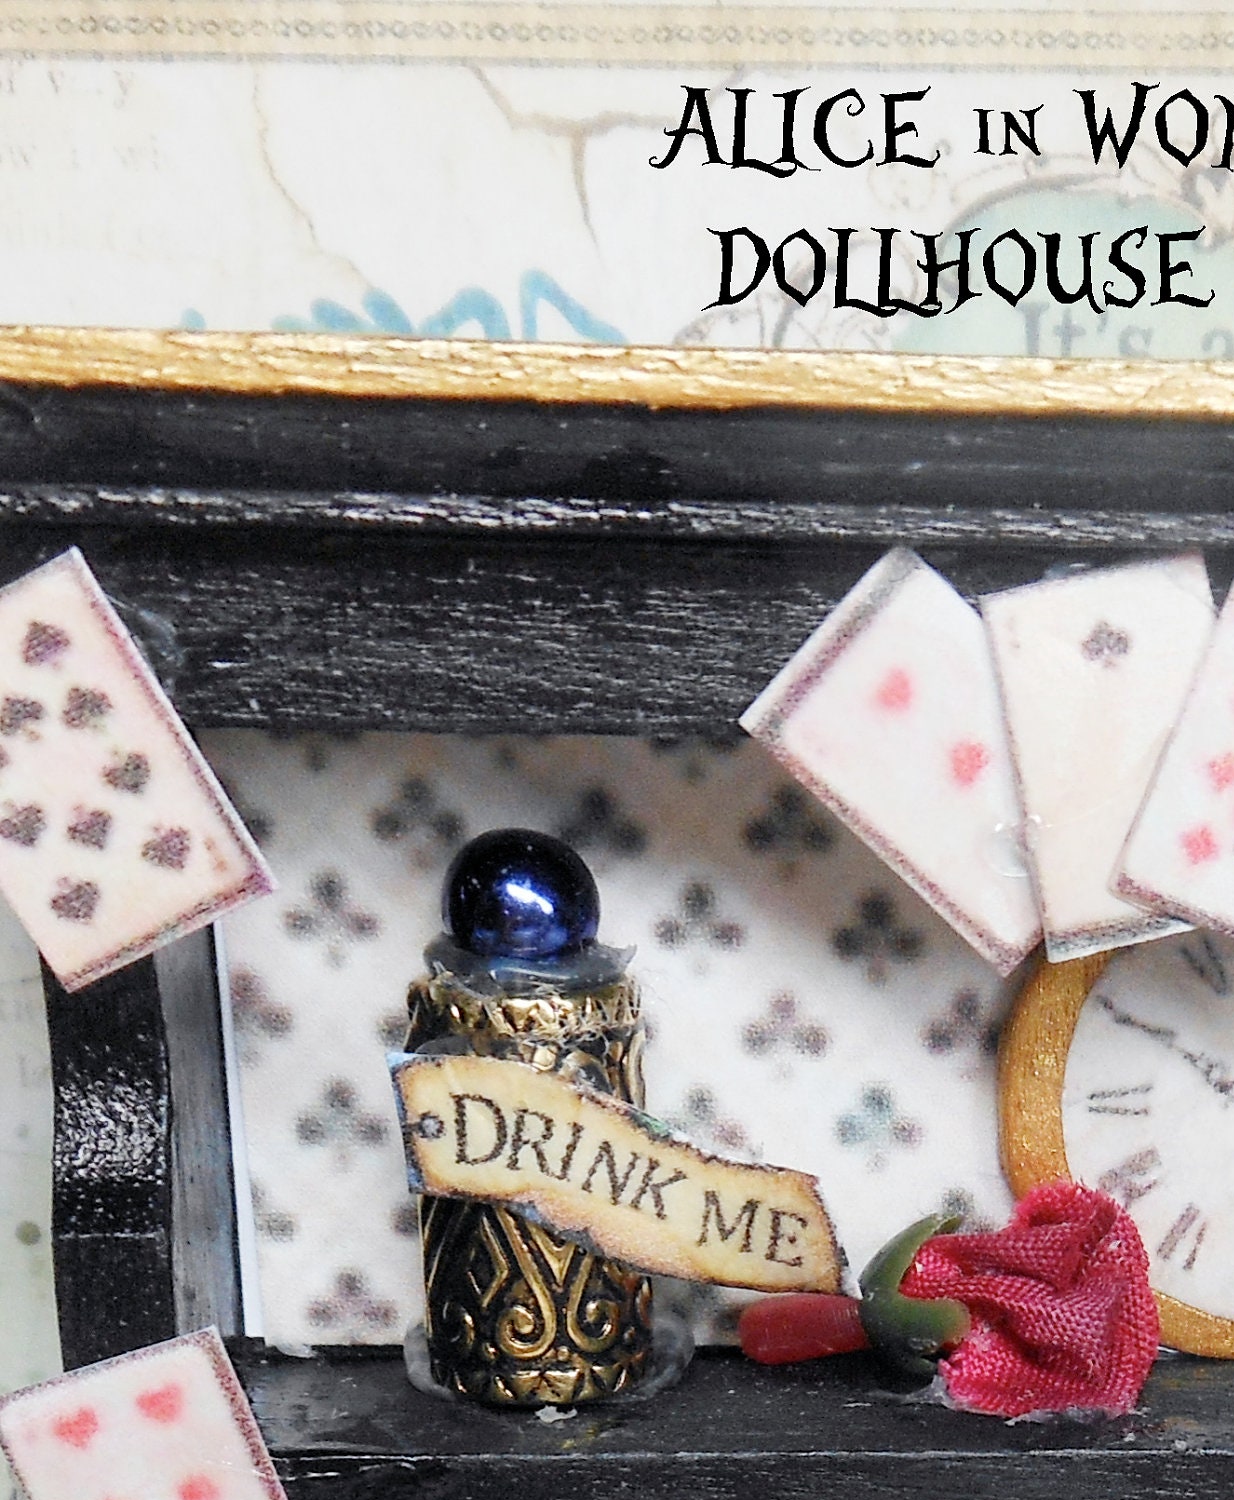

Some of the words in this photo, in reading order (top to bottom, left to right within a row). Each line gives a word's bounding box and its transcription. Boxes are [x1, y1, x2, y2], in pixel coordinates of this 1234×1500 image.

[1018, 302, 1154, 359] It's
[449, 1092, 688, 1220] DRINK
[696, 1189, 808, 1268] ME
